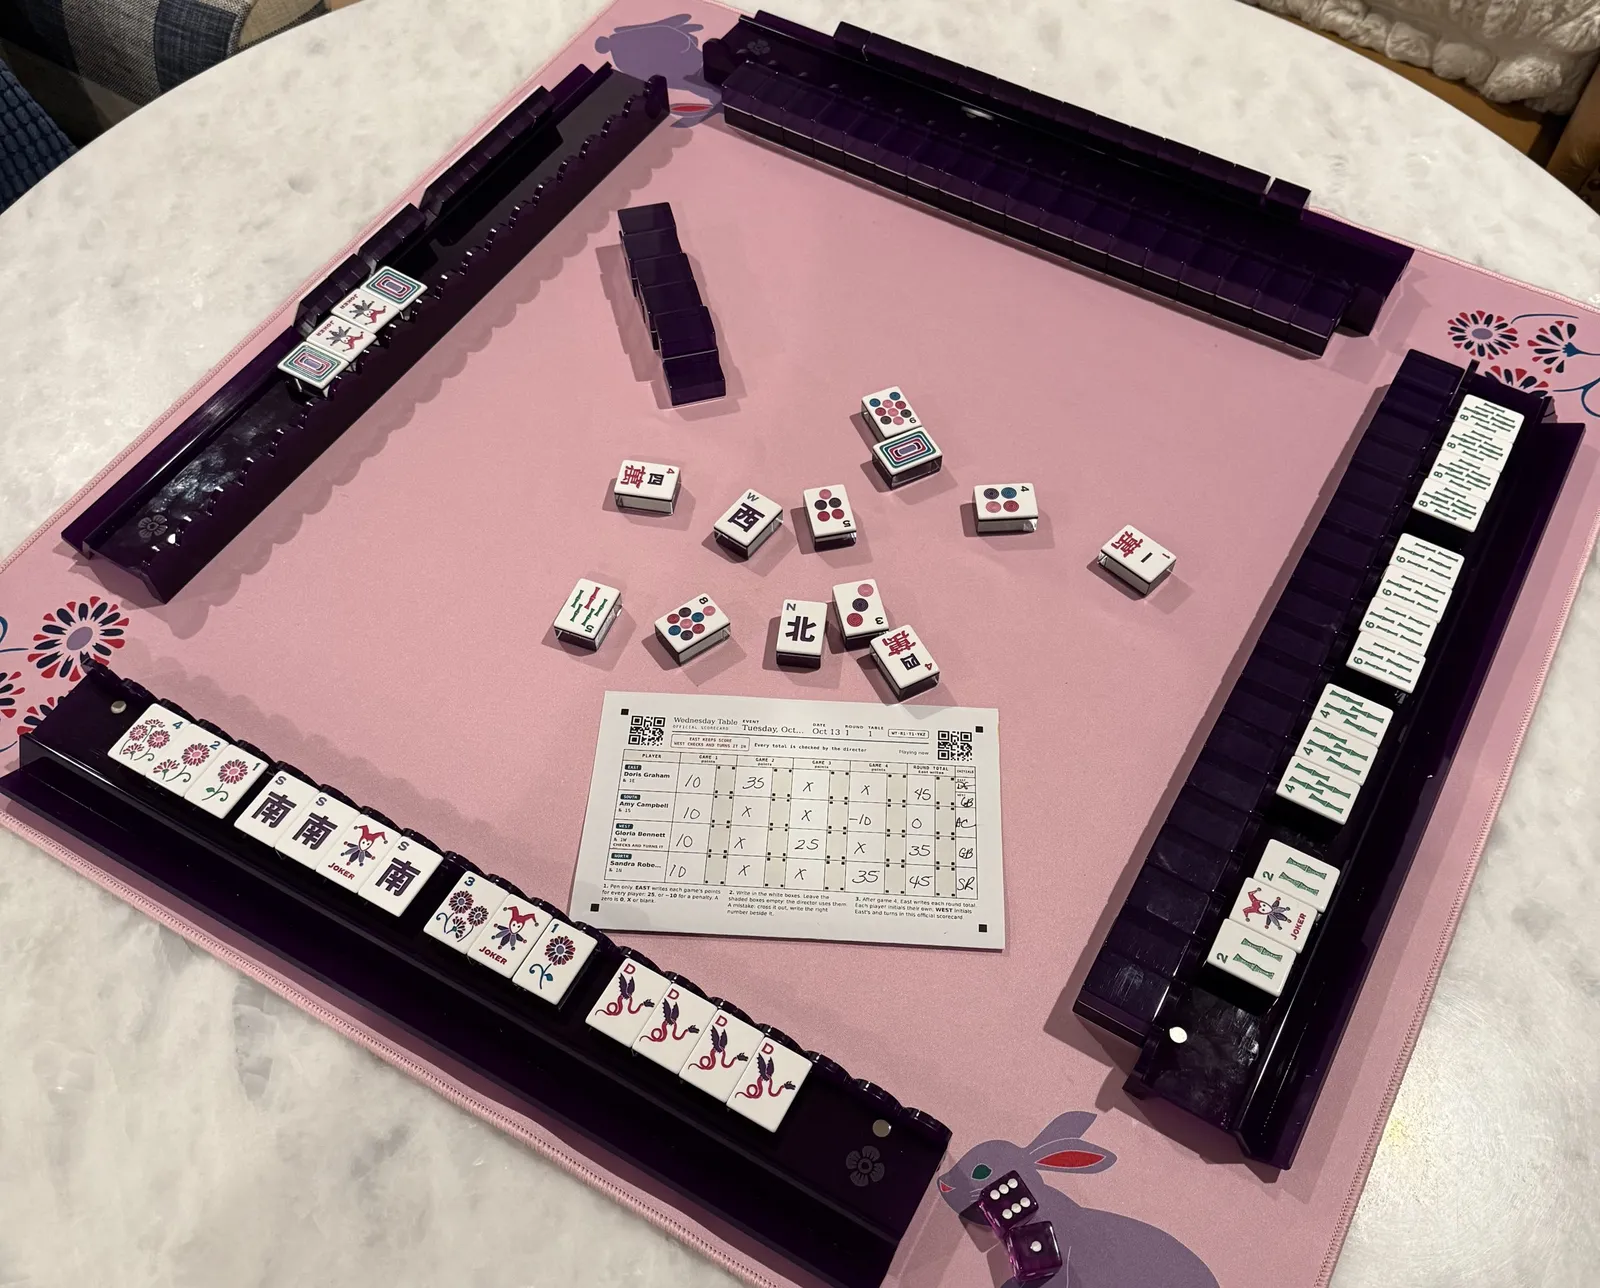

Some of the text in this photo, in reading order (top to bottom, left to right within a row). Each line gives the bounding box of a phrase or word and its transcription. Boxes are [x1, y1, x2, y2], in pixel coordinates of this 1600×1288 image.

[340, 293, 358, 309] JOKER
[316, 320, 334, 336] JOKER
[746, 492, 759, 502] W
[728, 503, 765, 532] 西
[843, 519, 851, 528] 5
[1396, 555, 1406, 563] 6
[1382, 588, 1392, 596] 6
[699, 597, 708, 605] 8
[786, 603, 797, 611] N
[875, 617, 884, 625] 3
[585, 624, 594, 633] 5
[785, 616, 817, 642] 北
[1353, 656, 1363, 664] 6
[924, 662, 933, 671] 4
[1320, 709, 1330, 718] 4
[172, 721, 183, 729] 4
[674, 717, 716, 725] Wednesday
[209, 740, 221, 750] 2
[1303, 746, 1313, 756] 4
[252, 762, 261, 771] 1
[275, 775, 287, 785] S
[685, 774, 701, 788] 10
[742, 776, 765, 789] 35
[1285, 783, 1295, 793] 4
[914, 788, 932, 801] 45
[315, 796, 327, 806] S
[251, 791, 297, 828] 南
[683, 807, 700, 819] 10
[292, 812, 338, 850] 南
[676, 833, 693, 847] 10
[794, 839, 819, 850] 25
[398, 841, 410, 851] S
[909, 844, 930, 856] 35
[328, 862, 355, 880] JOKER
[1263, 871, 1274, 881] 2
[374, 857, 421, 897] 南
[464, 876, 476, 886] 3
[852, 870, 880, 883] 35
[909, 876, 933, 889] 45
[551, 923, 560, 933] 1
[1290, 913, 1307, 940] JOKER
[479, 946, 508, 965] JOKER
[1217, 953, 1228, 963] 2
[623, 963, 636, 975] D
[667, 988, 680, 1000] D
[715, 1015, 728, 1027] D
[761, 1042, 774, 1055] D
